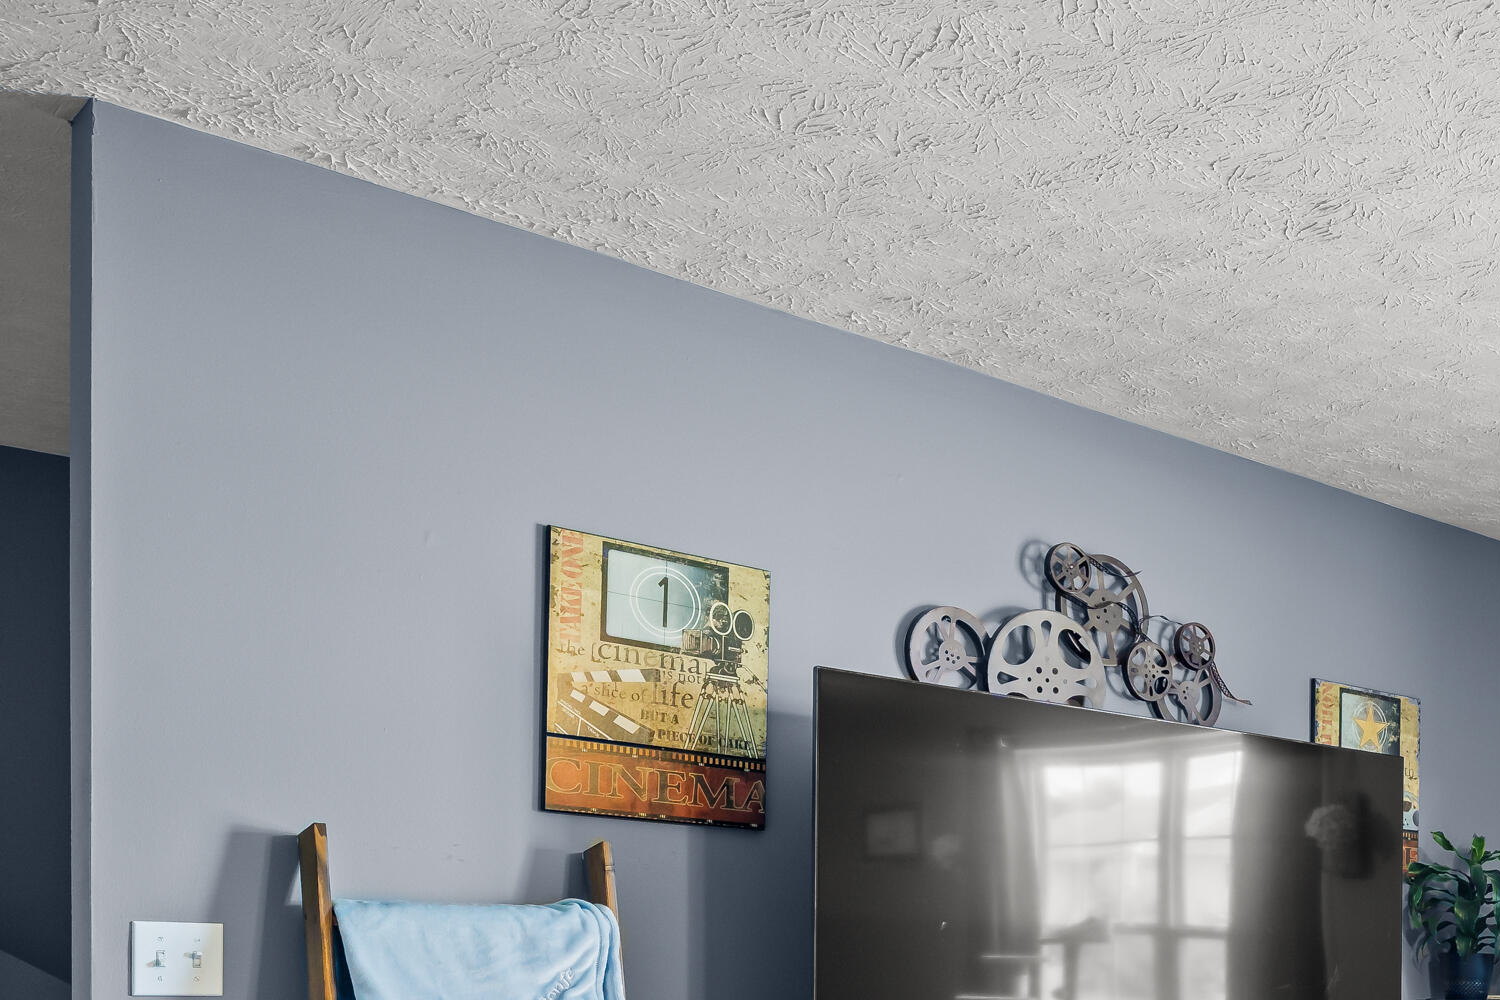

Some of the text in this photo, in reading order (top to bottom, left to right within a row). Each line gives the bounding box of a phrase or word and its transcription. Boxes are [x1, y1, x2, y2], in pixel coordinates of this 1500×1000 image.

[657, 576, 669, 628] 1
[559, 640, 585, 656] the
[678, 673, 703, 685] not
[594, 682, 626, 700] slice
[631, 687, 648, 702] of
[651, 681, 694, 709] life
[640, 709, 680, 725] BUT A
[546, 756, 765, 814] CINEMA
